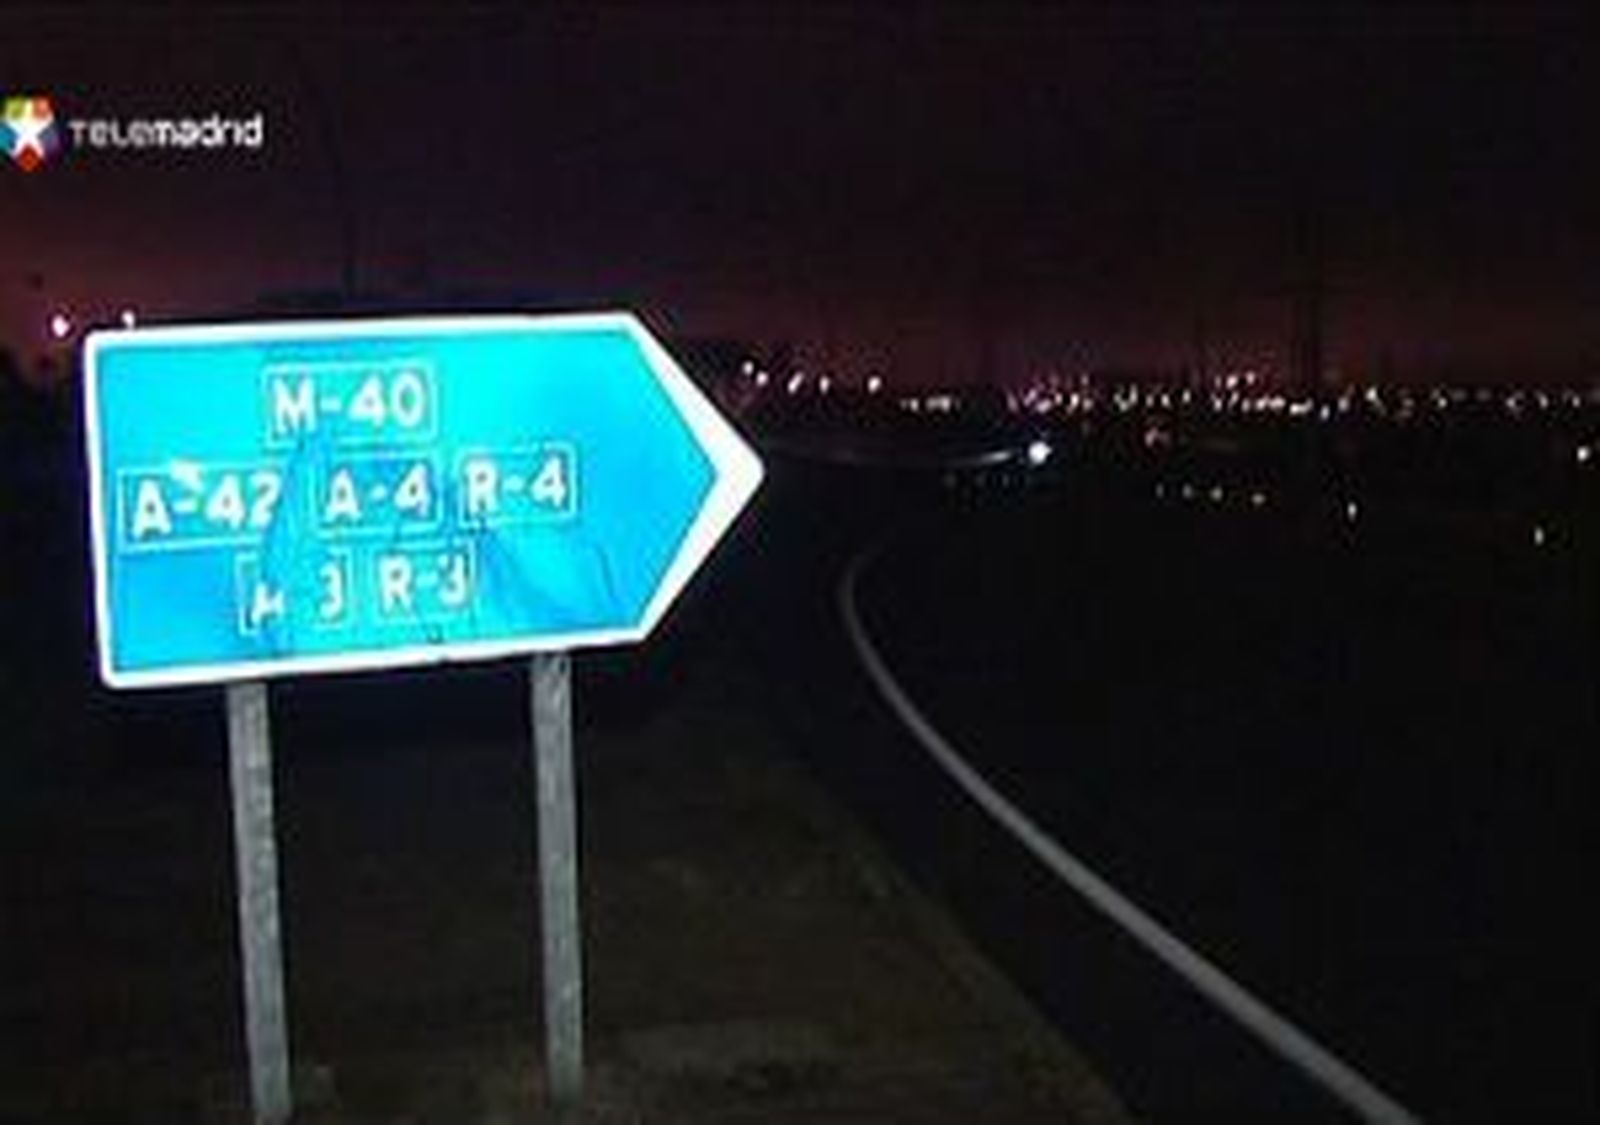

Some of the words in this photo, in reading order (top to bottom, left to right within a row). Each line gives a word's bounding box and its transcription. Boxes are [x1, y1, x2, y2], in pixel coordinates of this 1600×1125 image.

[271, 370, 429, 435] M-40
[132, 471, 284, 539] A-42
[325, 463, 432, 523] A-4
[465, 454, 568, 514] R-4
[378, 553, 468, 614] R-3
